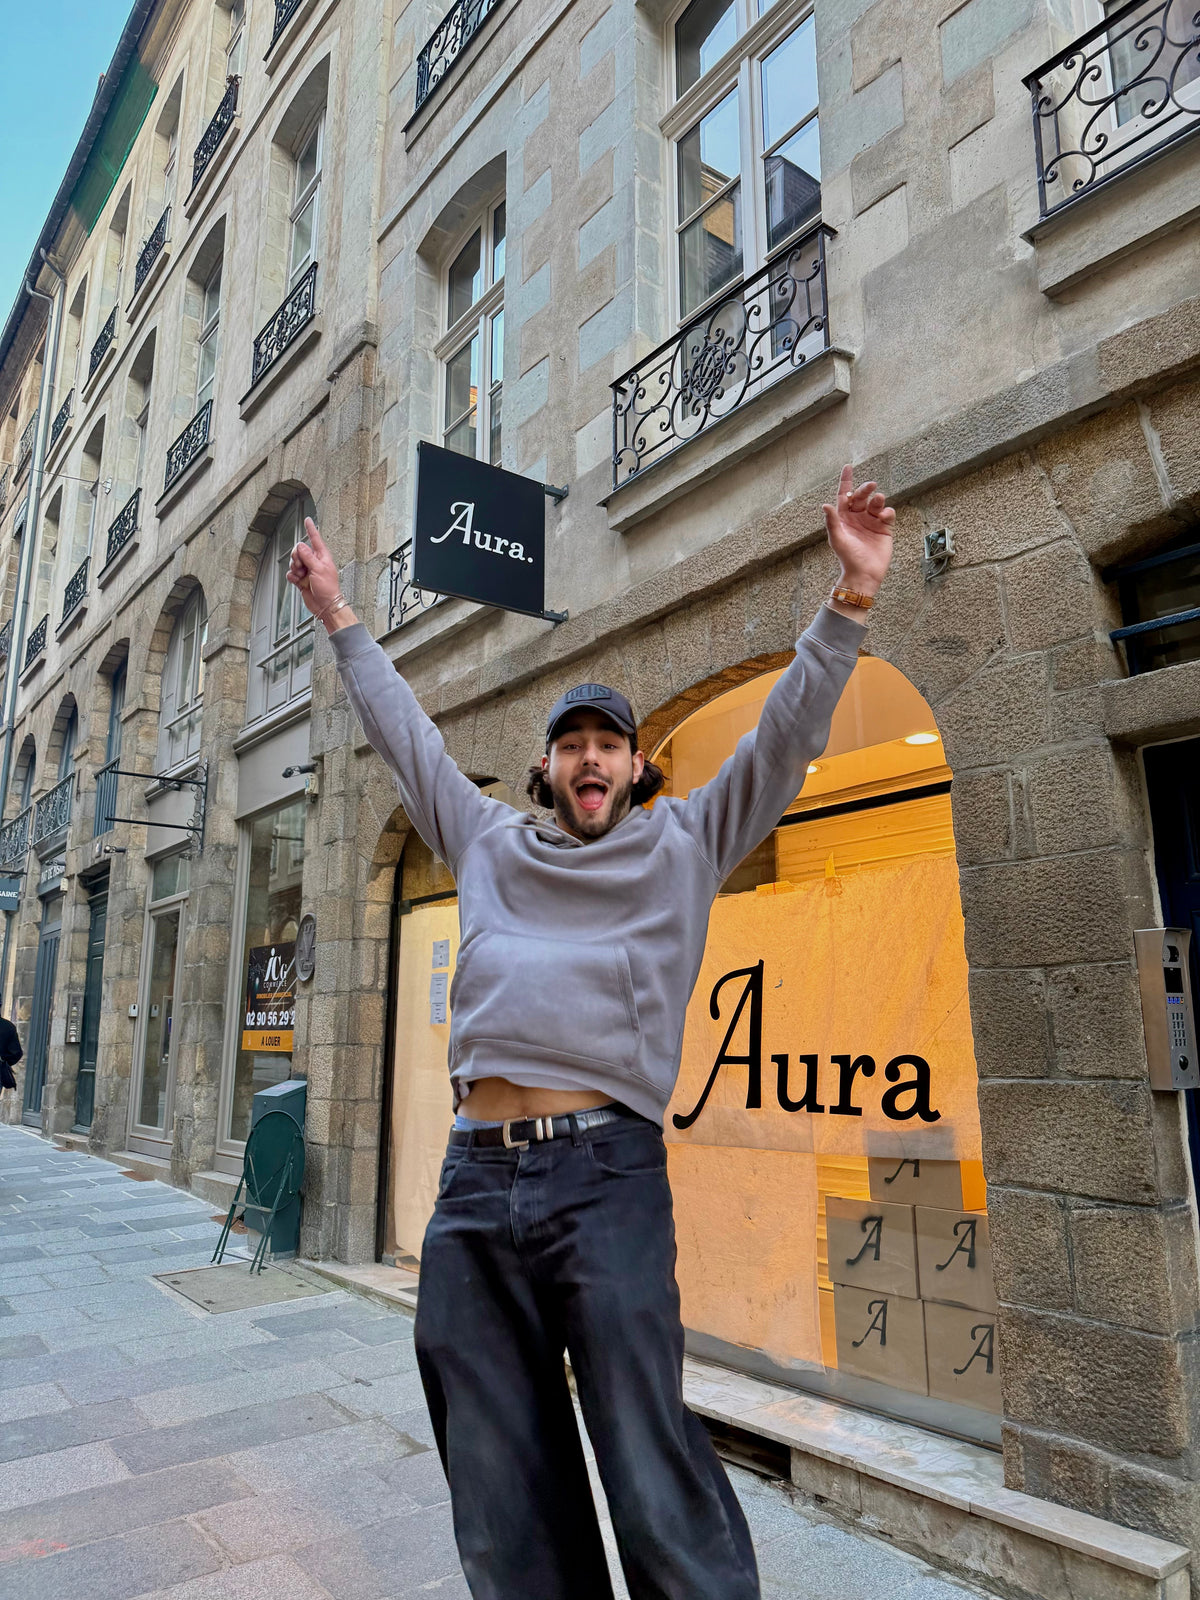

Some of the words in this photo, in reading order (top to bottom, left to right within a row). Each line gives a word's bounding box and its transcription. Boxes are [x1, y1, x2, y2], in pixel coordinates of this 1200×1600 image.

[429, 501, 534, 564] Aura.
[246, 1010, 256, 1026] 02
[256, 1011, 266, 1026] 90
[267, 1011, 278, 1026] 56
[278, 1010, 289, 1026] 29
[265, 1036, 281, 1047] LOUER
[672, 958, 942, 1130] Aura
[845, 1215, 884, 1266] A
[935, 1219, 977, 1271] A
[851, 1299, 889, 1348] A
[953, 1323, 995, 1375] A
